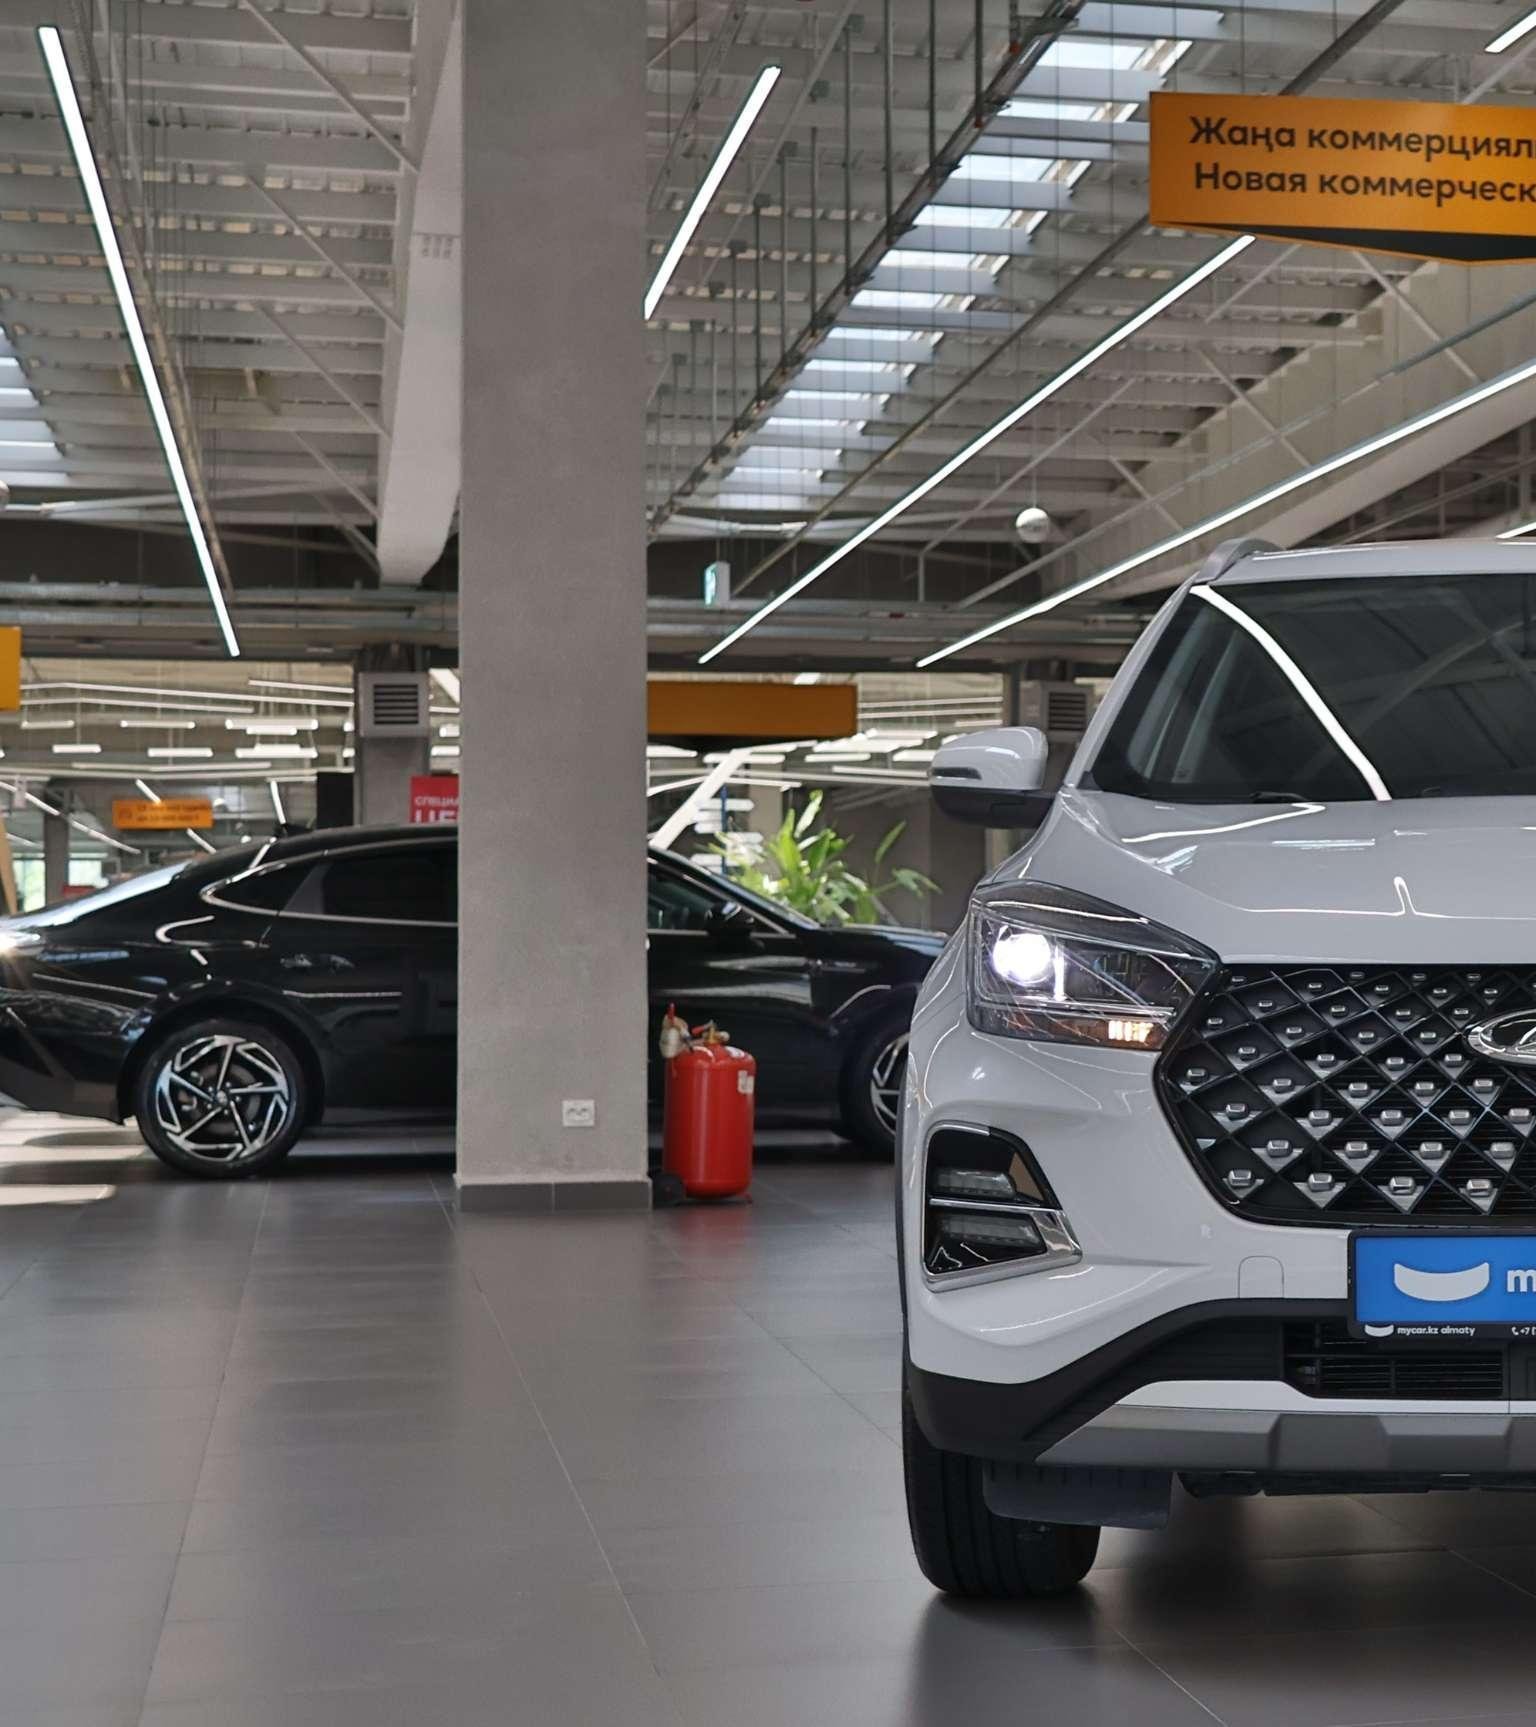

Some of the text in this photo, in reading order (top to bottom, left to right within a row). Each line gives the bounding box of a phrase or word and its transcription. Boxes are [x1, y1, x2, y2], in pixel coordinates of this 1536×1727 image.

[1189, 115, 1297, 153] Жаңа
[1194, 162, 1307, 193] Новая
[1397, 1324, 1476, 1336] mycar.kz almaty
[1520, 1326, 1530, 1335] +7
